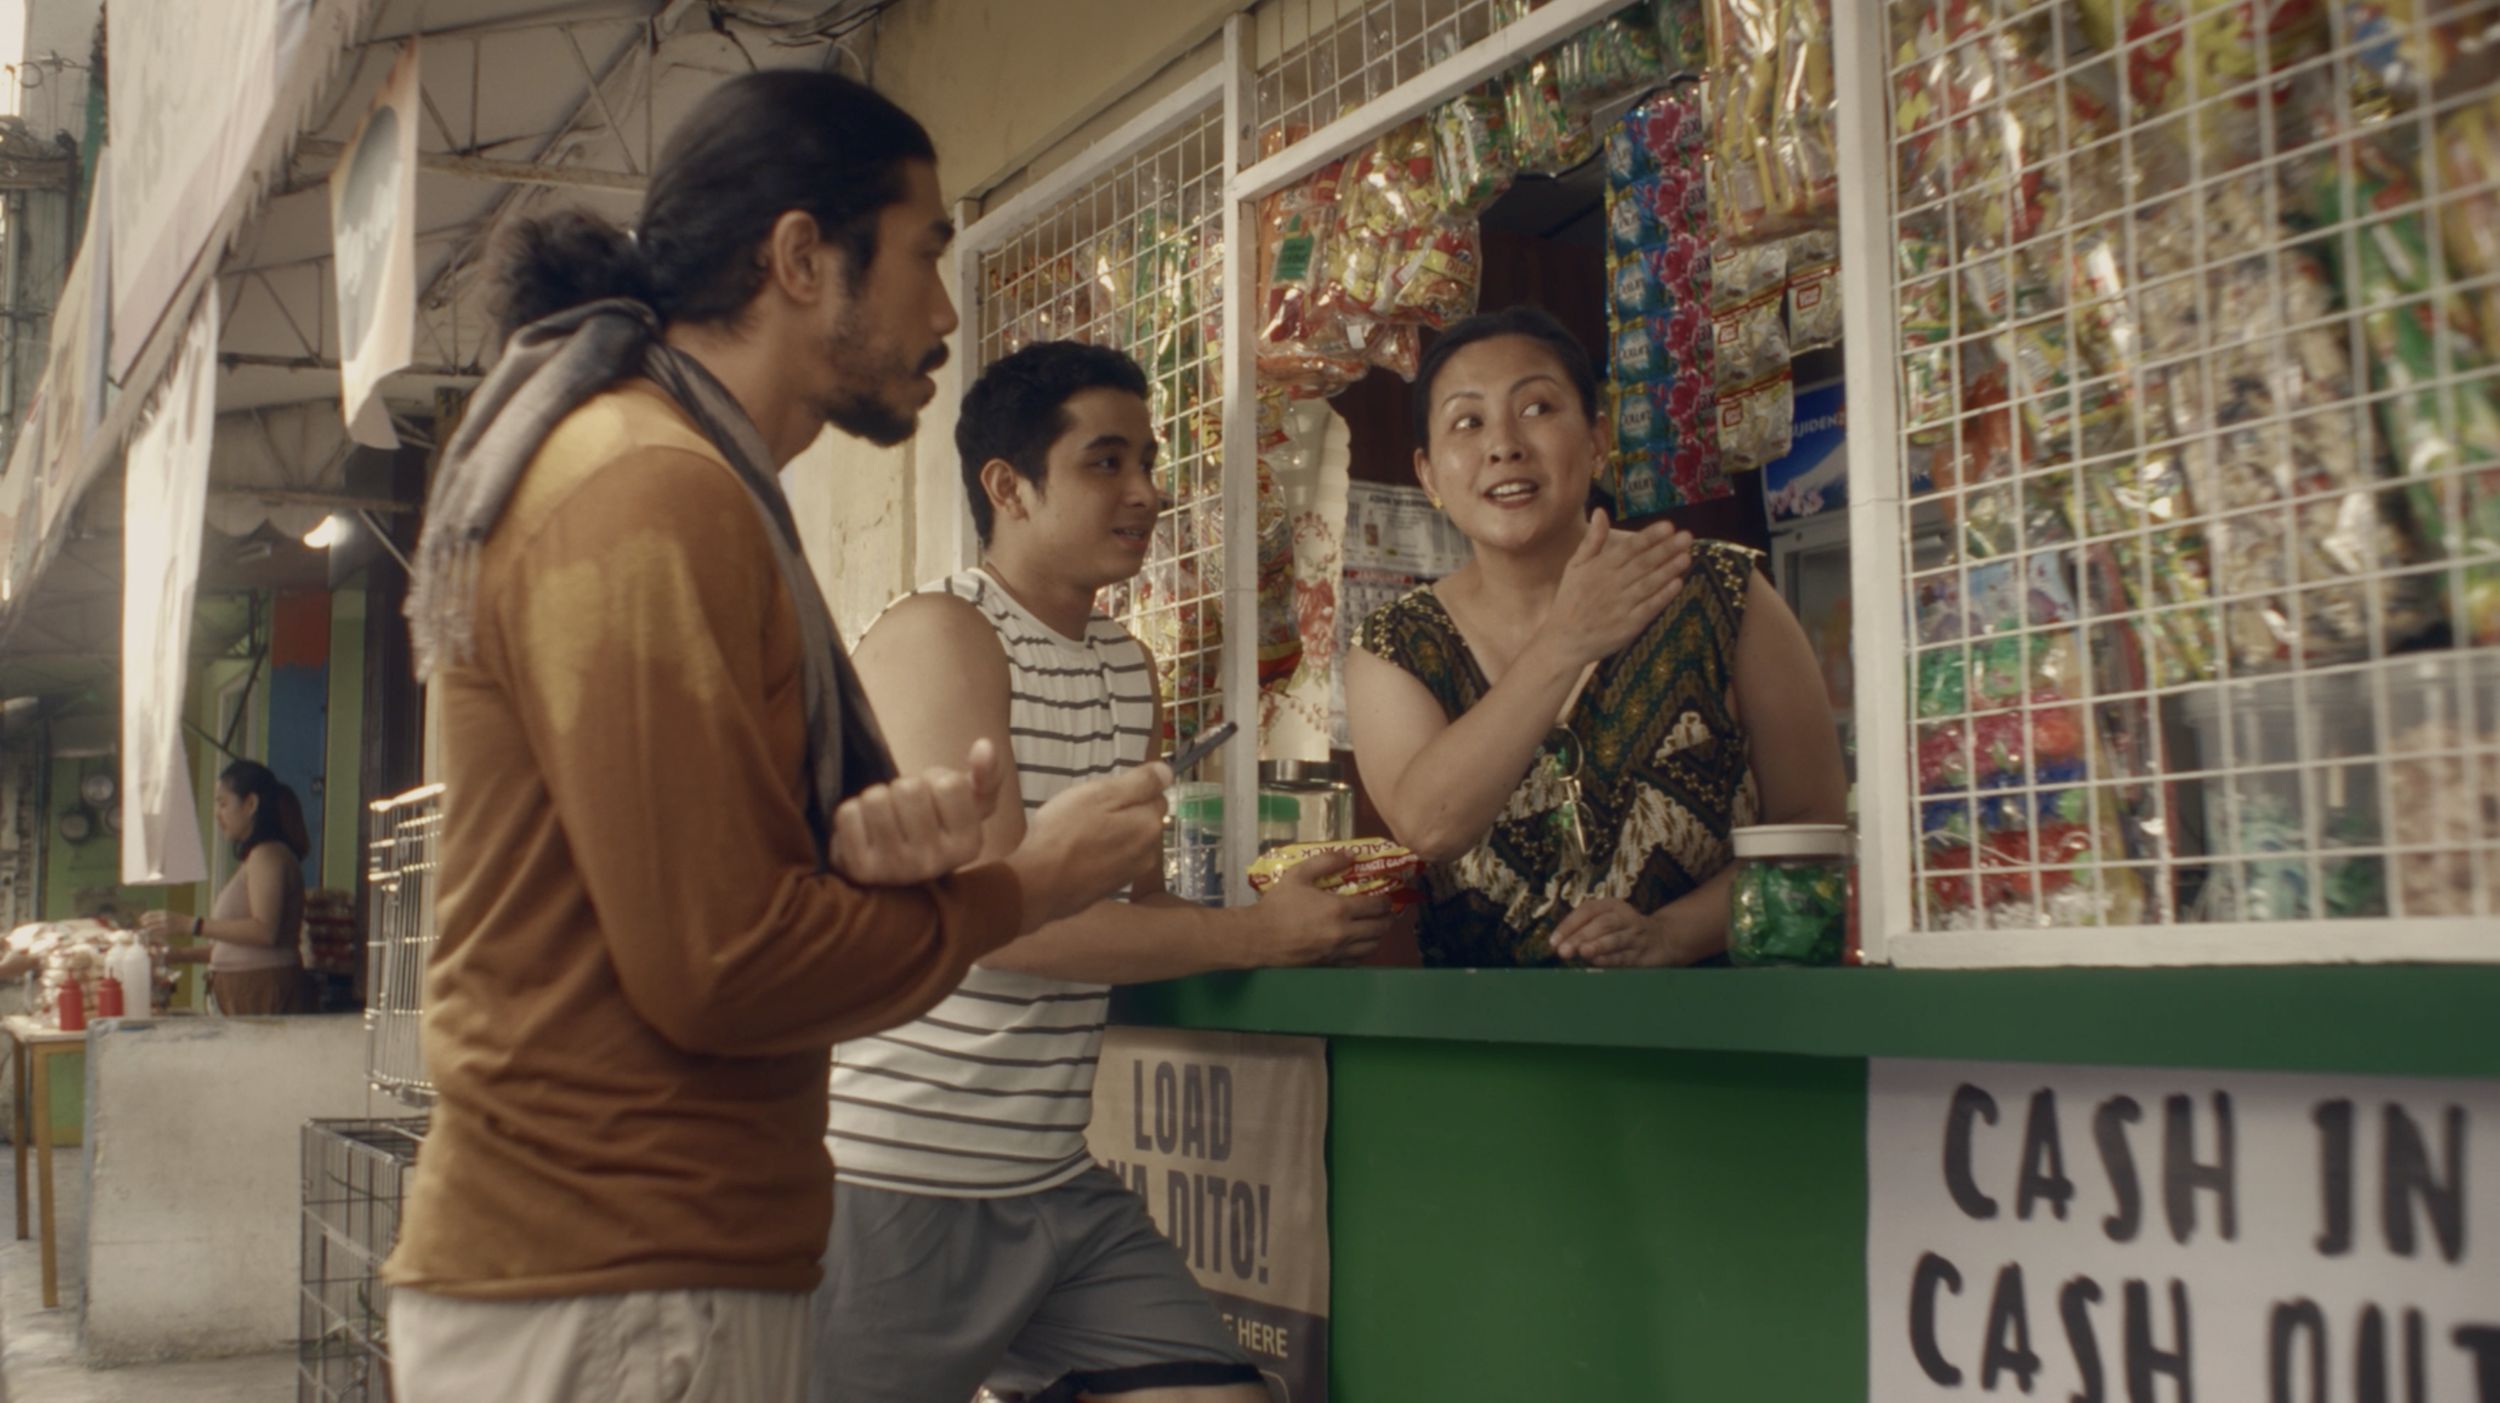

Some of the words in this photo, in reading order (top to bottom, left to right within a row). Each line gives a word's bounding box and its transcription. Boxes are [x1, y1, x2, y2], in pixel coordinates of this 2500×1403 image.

[1133, 1059, 1233, 1163] LOAD
[1167, 1169, 1270, 1285] DITO!
[1942, 1081, 2240, 1245] CASH
[2310, 1097, 2468, 1264] IN
[1238, 1317, 1288, 1358] HERE
[1908, 1250, 2195, 1403] CASH
